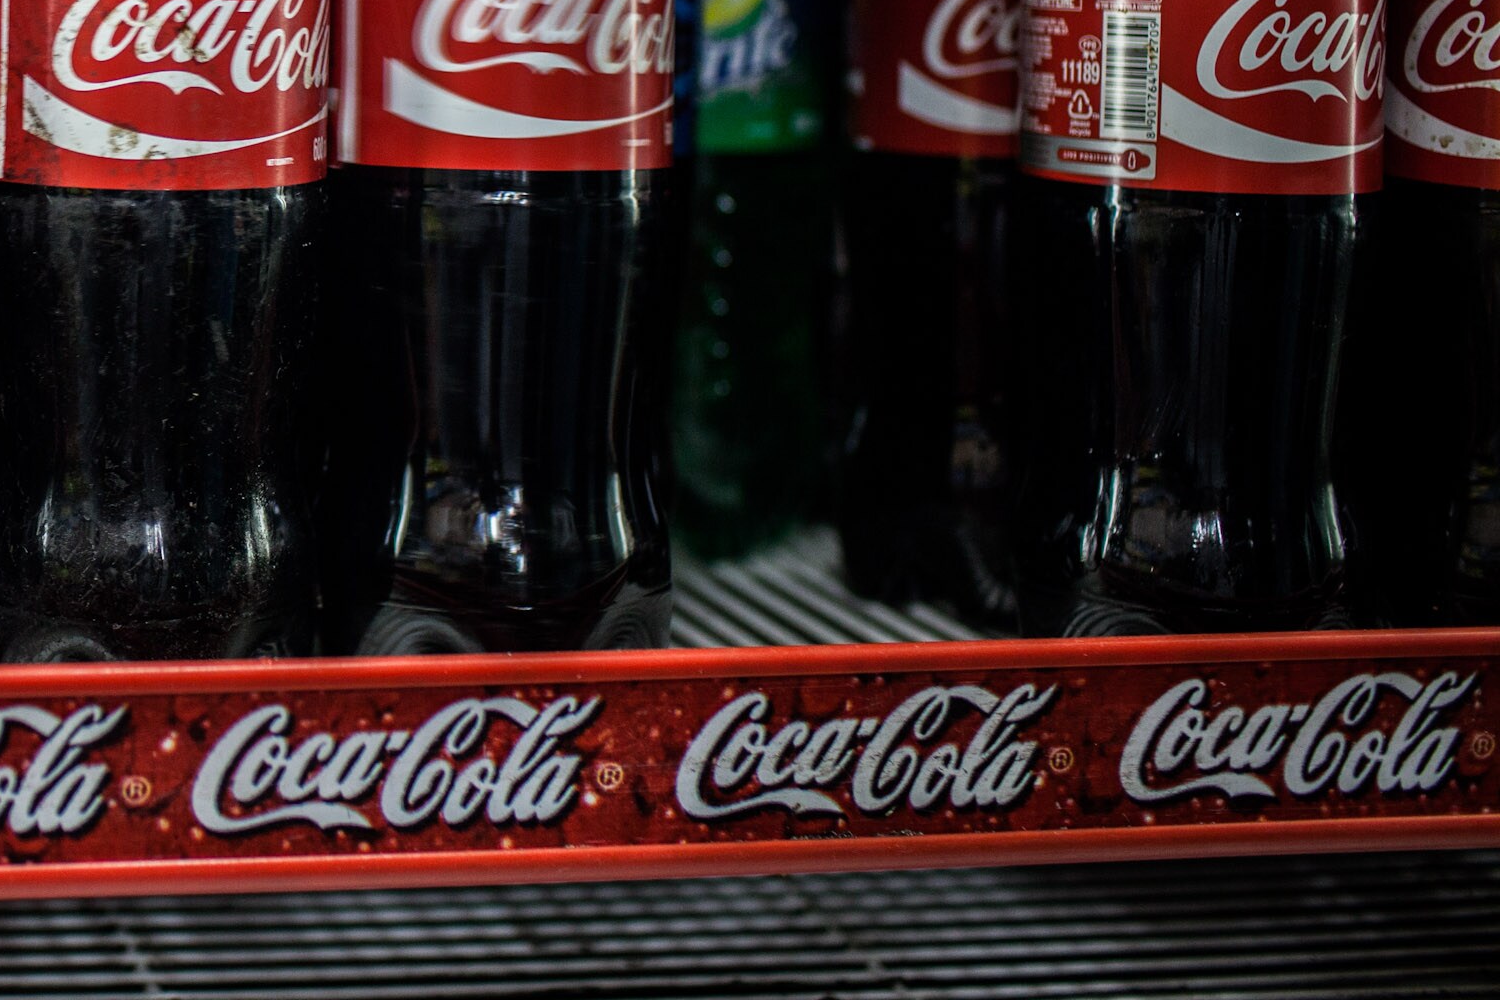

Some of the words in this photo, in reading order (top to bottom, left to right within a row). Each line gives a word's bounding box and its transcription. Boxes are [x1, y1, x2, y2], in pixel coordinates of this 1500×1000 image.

[1061, 58, 1100, 85] 11189
[192, 694, 601, 833] Coca-Cola
[676, 682, 1058, 819] Coca-Cola
[1119, 670, 1478, 801] Coca-Cola
